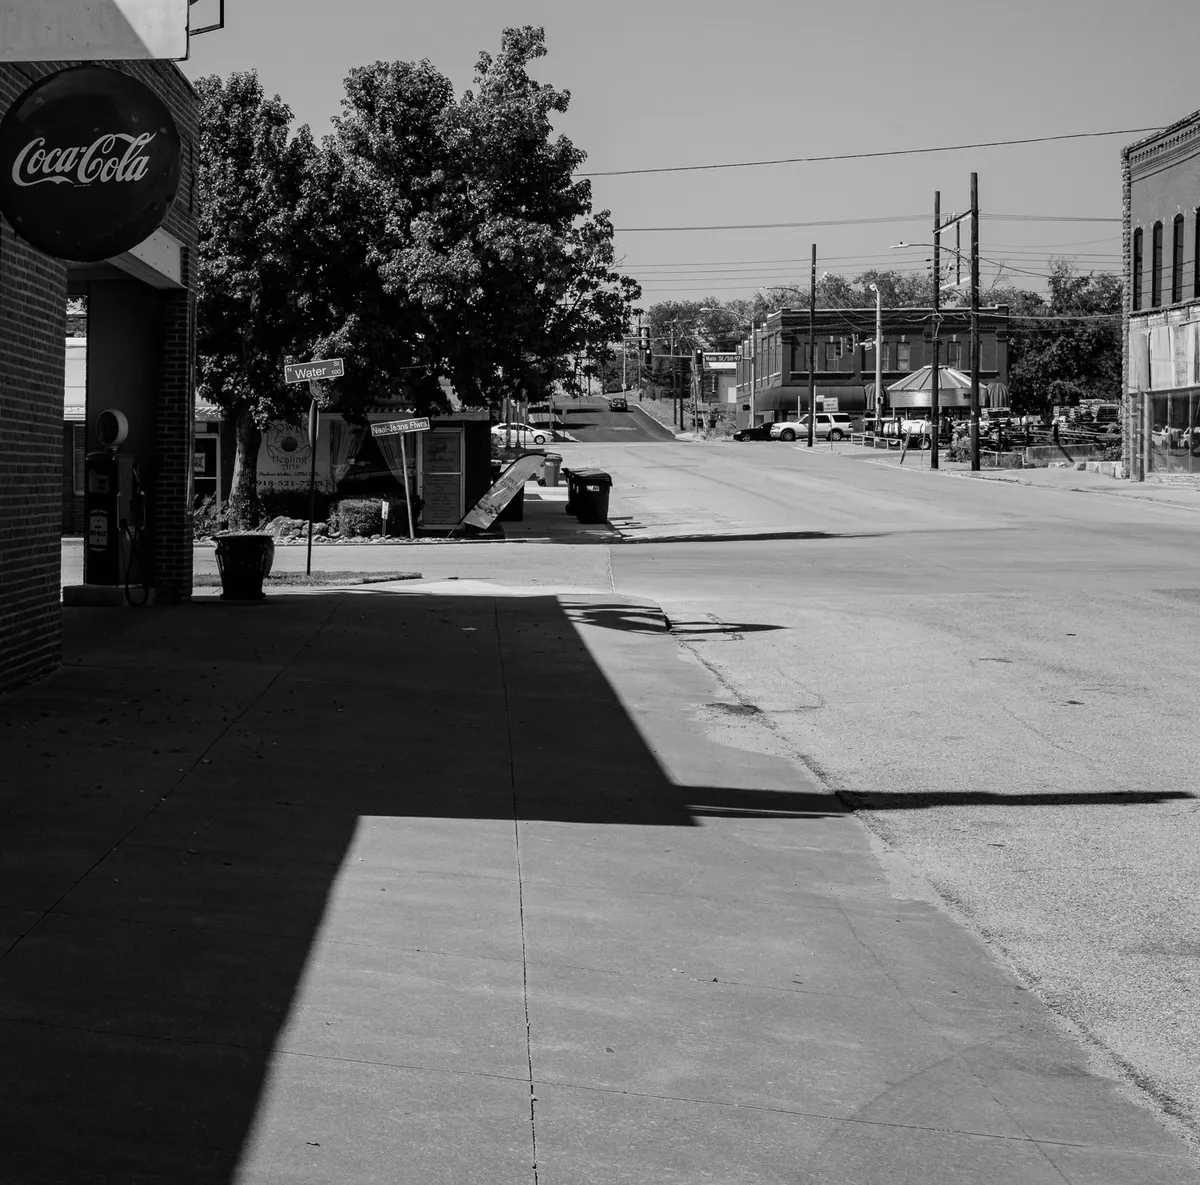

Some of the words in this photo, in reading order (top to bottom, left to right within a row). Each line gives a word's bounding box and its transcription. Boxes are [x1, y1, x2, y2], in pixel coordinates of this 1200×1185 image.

[11, 131, 157, 187] Coca-Cola
[294, 367, 327, 379] Water
[272, 456, 308, 465] Healing
